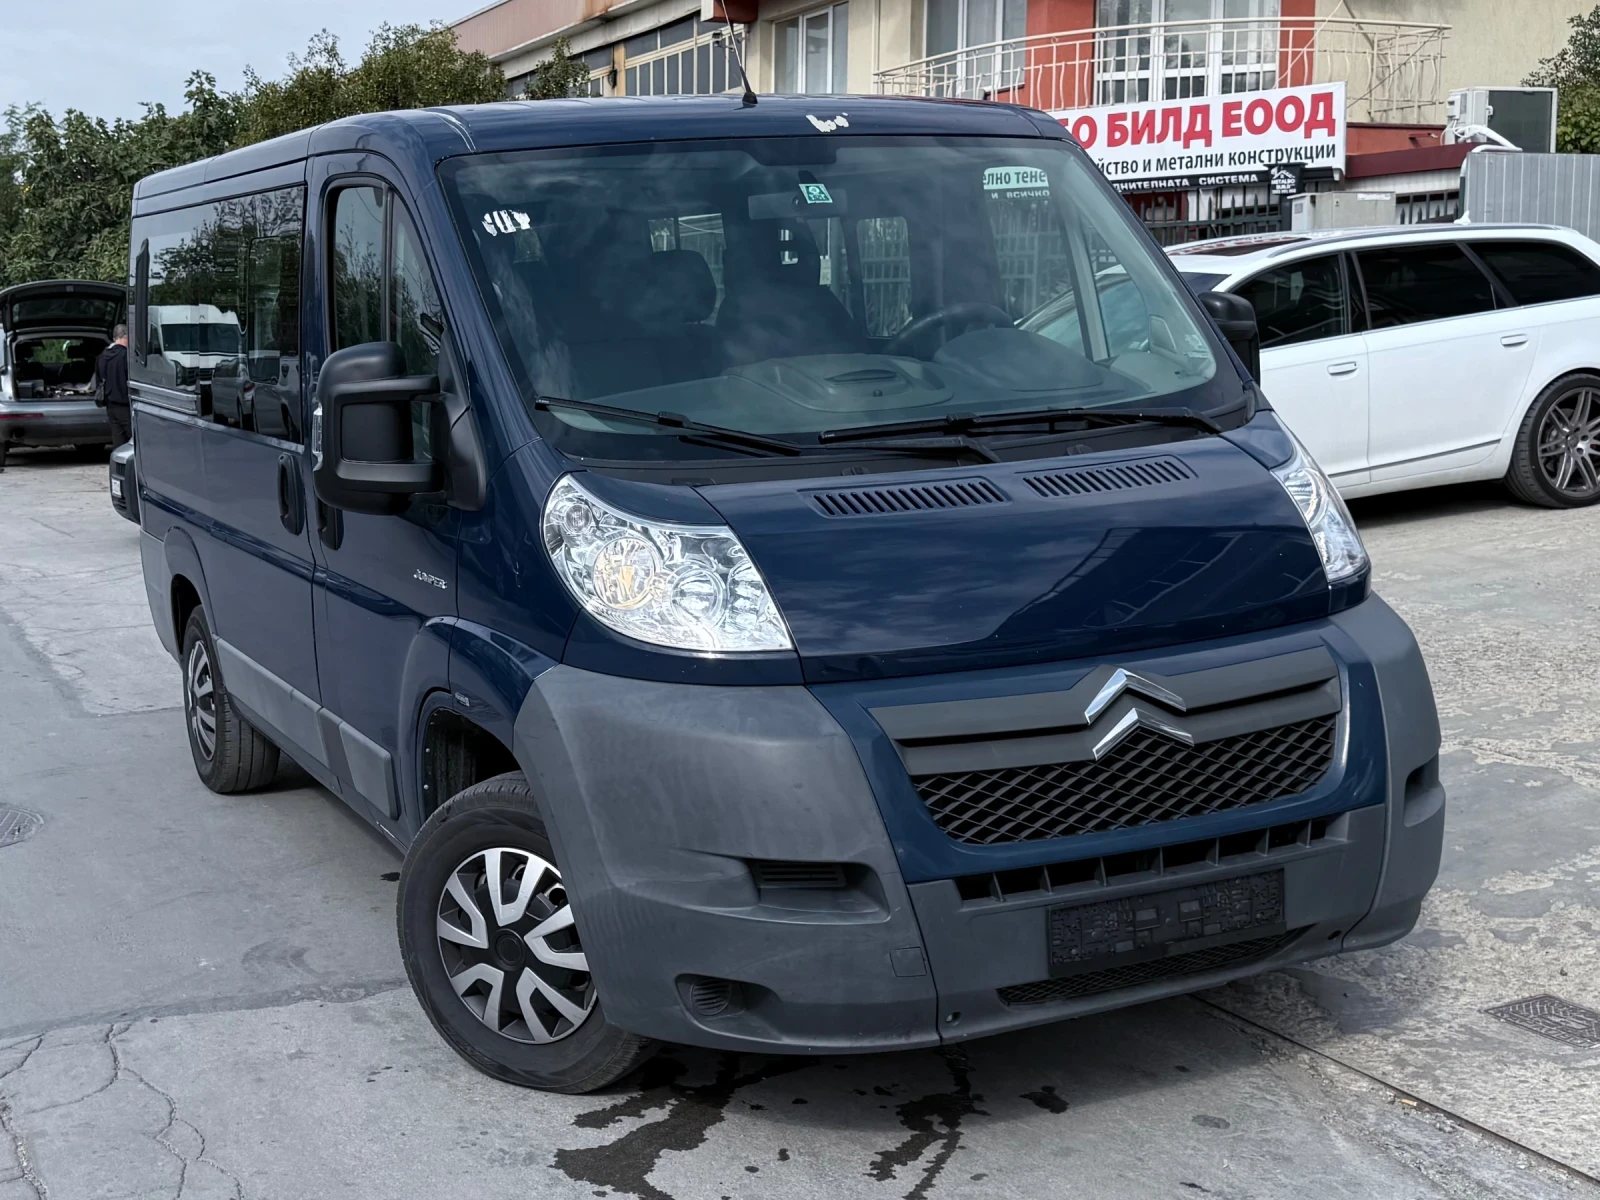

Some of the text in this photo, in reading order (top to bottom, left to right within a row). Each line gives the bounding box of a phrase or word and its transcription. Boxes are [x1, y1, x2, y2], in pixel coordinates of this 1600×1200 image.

[1107, 104, 1212, 149] БИЛД
[1222, 91, 1336, 139] ЕООД
[1142, 159, 1152, 173] и
[1155, 152, 1224, 172] метални
[1228, 143, 1336, 167] конструкции
[1198, 173, 1259, 186] СИСТЕМА
